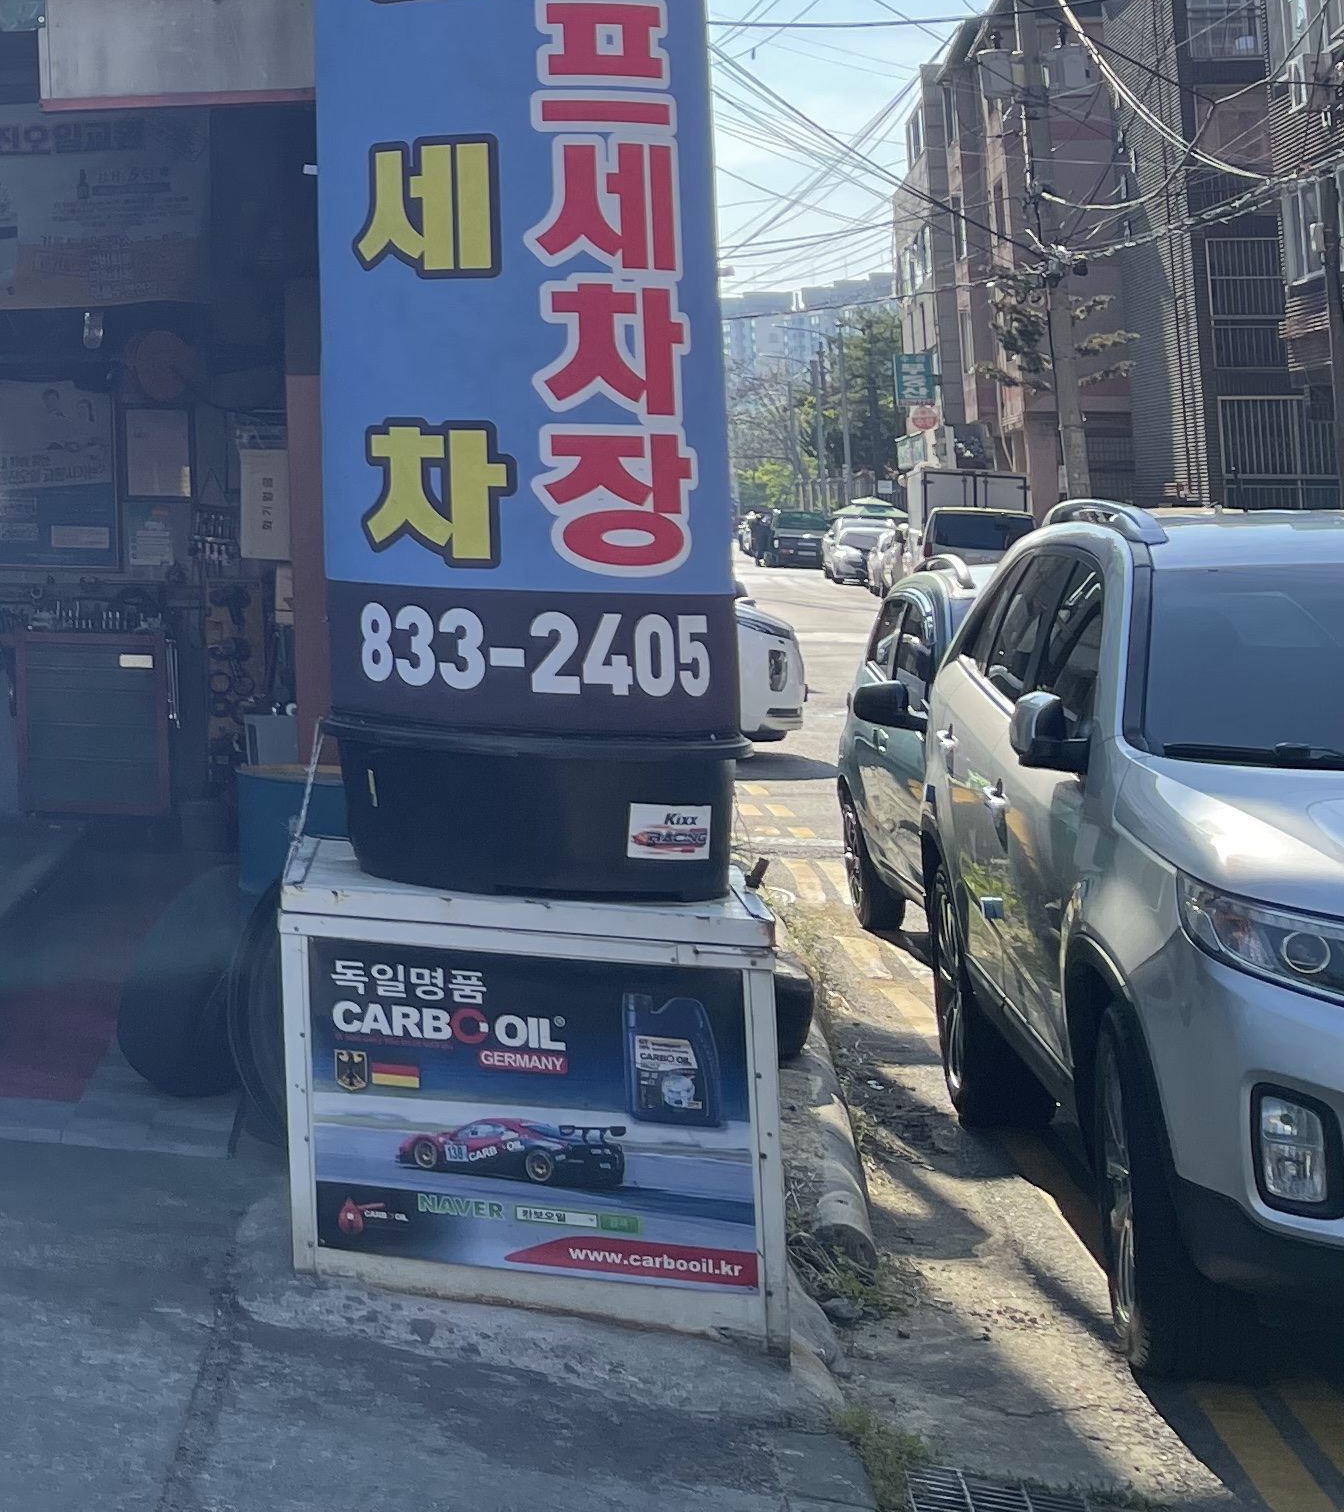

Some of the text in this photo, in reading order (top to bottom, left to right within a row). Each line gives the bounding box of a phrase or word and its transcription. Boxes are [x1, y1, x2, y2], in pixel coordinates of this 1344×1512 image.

[359, 599, 711, 699] 833-2405
[664, 812, 699, 826] Kixx
[330, 959, 488, 1005] 독일명품
[480, 1049, 565, 1072] GERMANY
[416, 1192, 505, 1220] NAVER
[568, 1246, 744, 1278] www.carbooil.kr
